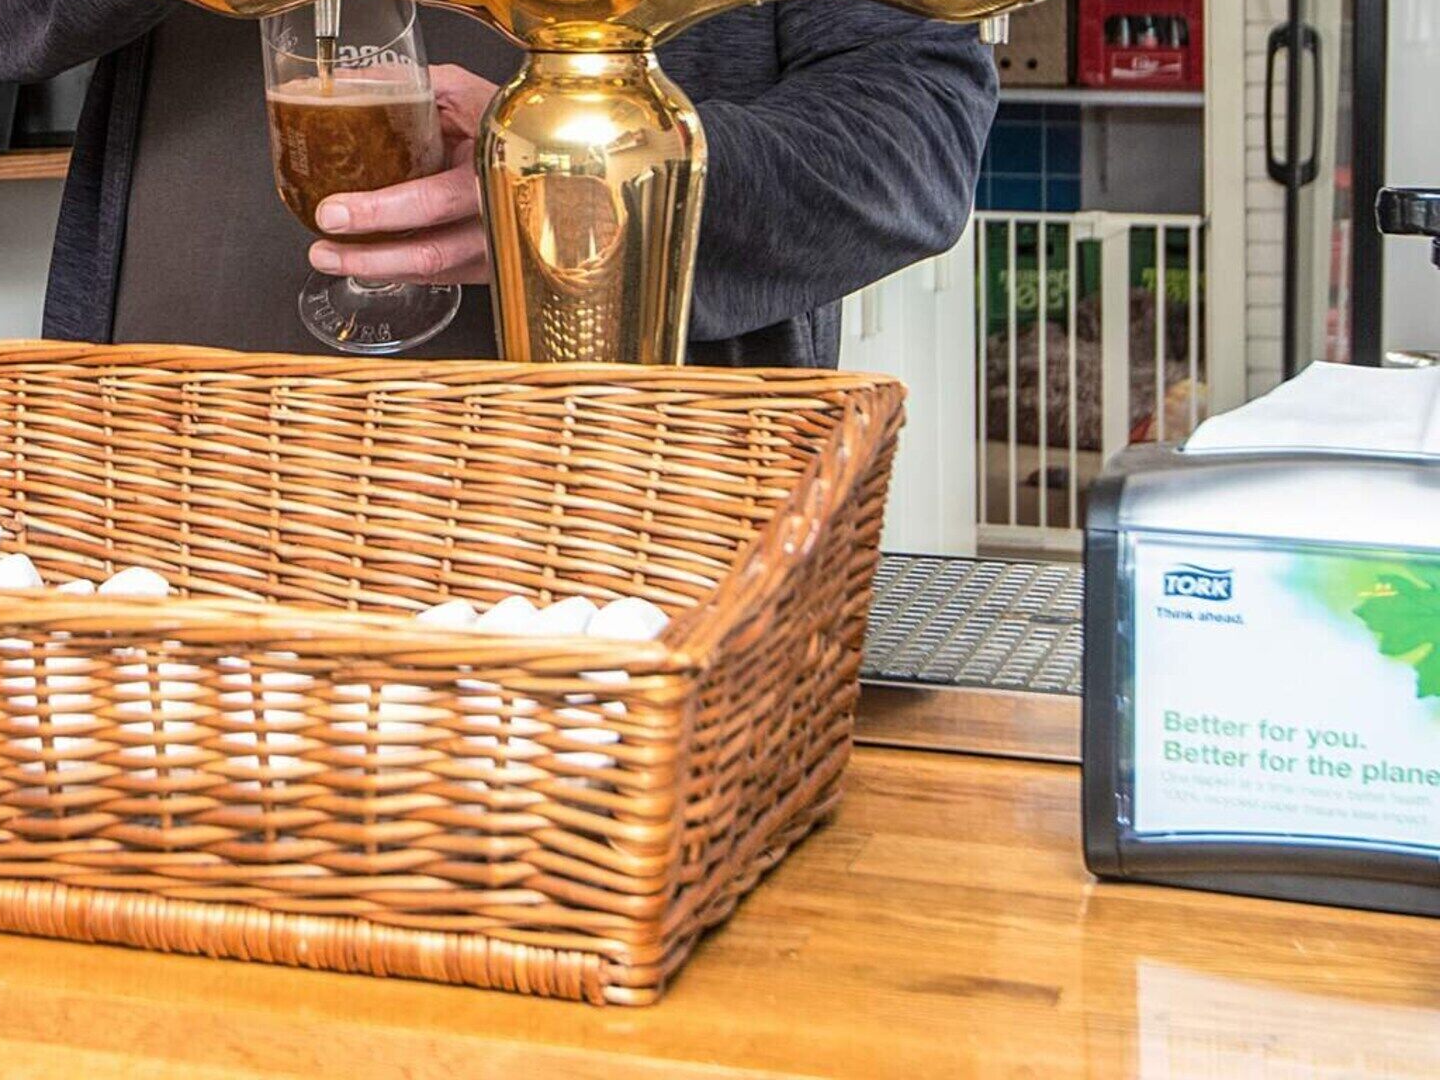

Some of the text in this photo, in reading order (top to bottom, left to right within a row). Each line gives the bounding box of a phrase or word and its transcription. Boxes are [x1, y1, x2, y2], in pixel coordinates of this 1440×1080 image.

[1166, 573, 1231, 598] TORK
[1162, 709, 1368, 751] Better for you.
[1162, 740, 1440, 788] Better for the plane
